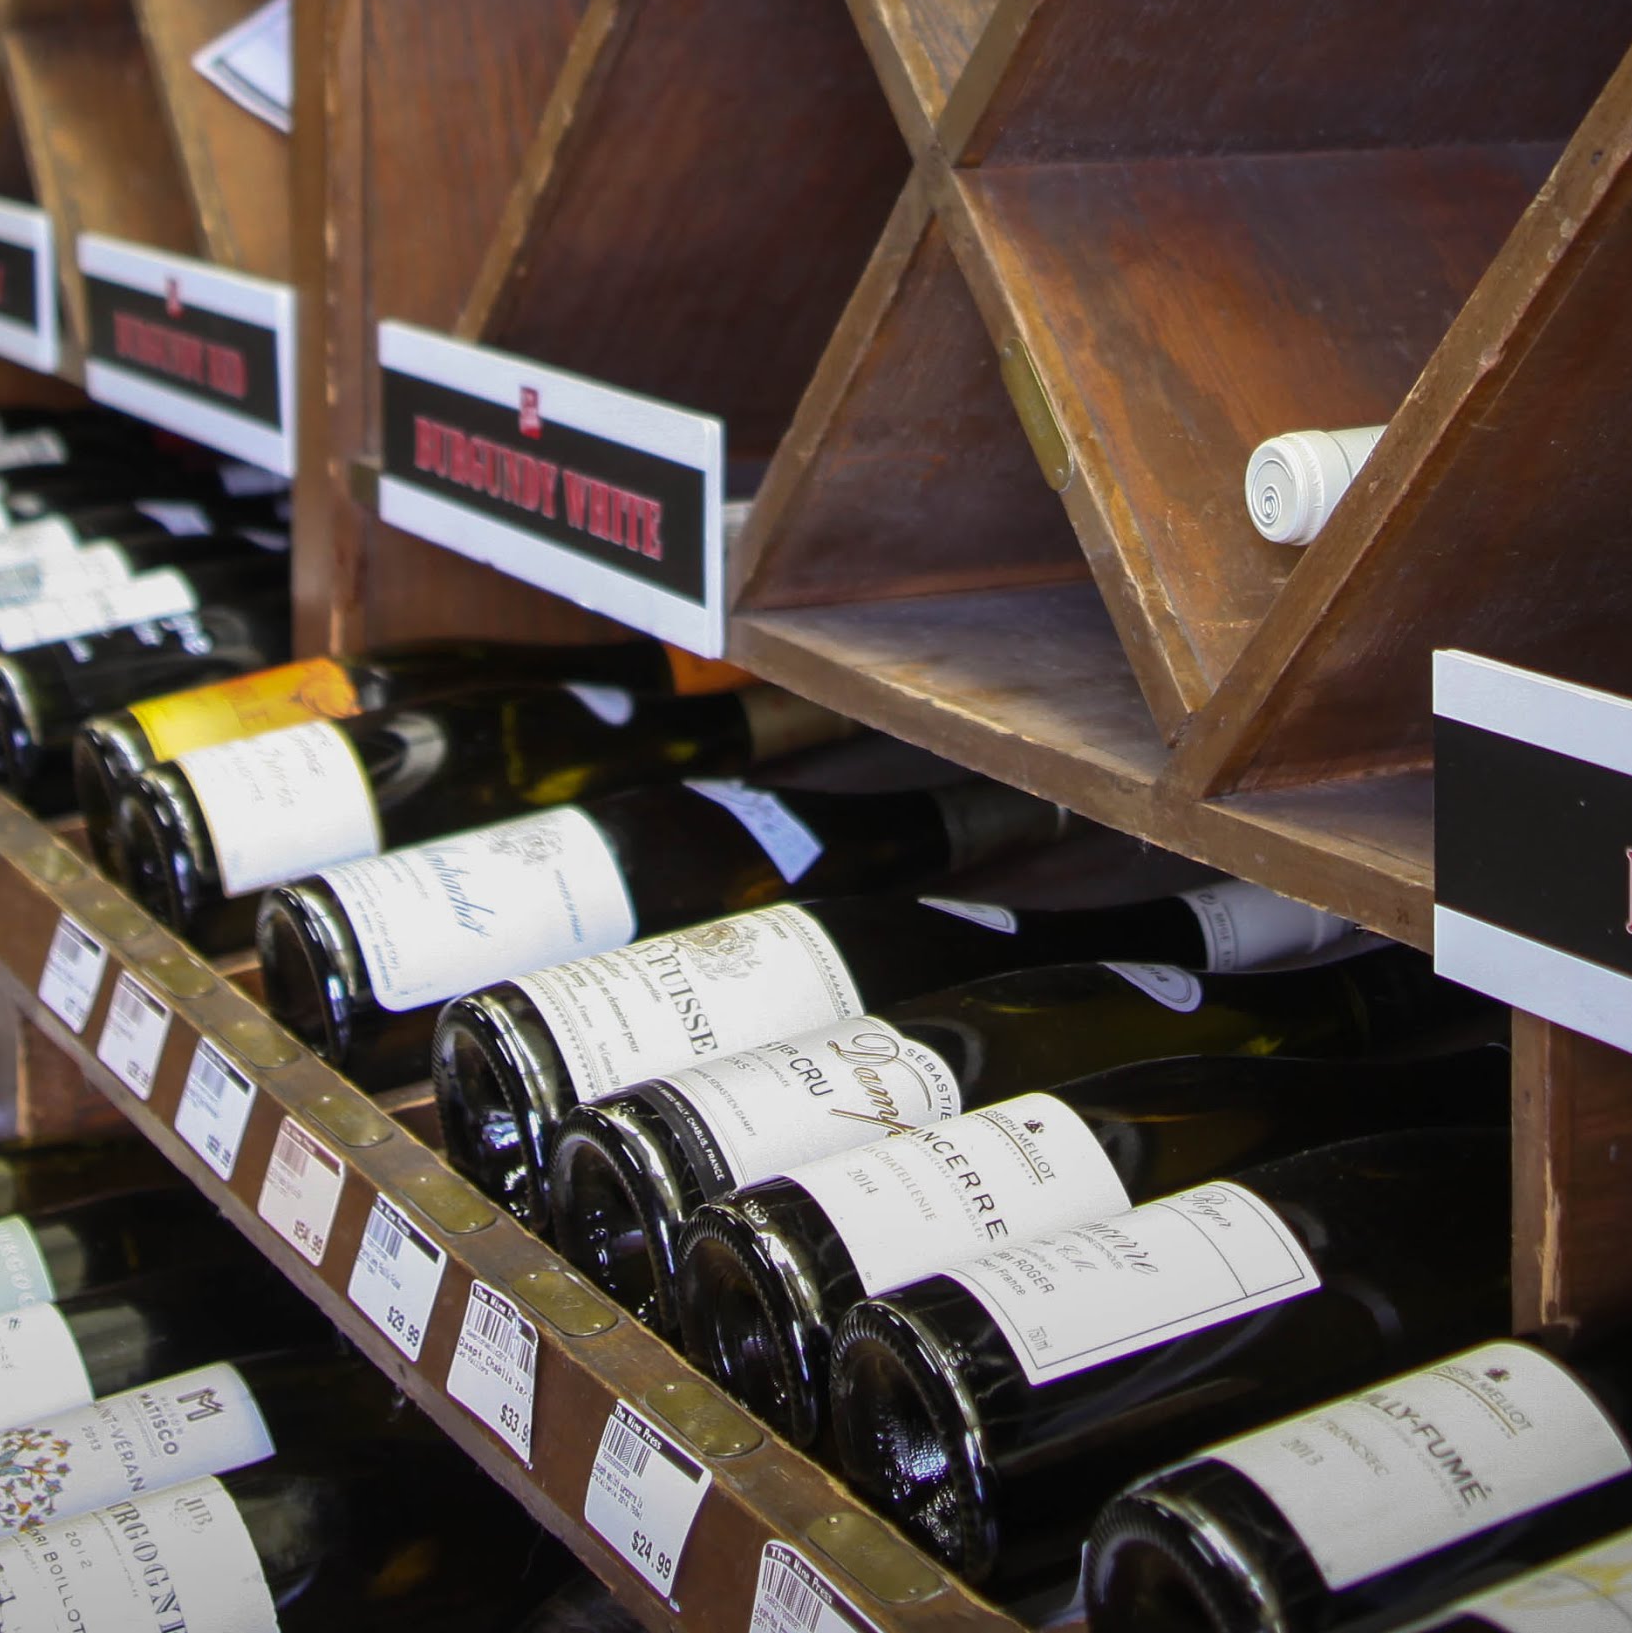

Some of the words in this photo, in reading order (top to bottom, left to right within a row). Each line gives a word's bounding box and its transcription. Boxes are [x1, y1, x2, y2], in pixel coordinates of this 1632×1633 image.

[413, 415, 559, 520] BURGUNDY
[562, 469, 664, 561] WHITE
[790, 1056, 834, 1098] CRU
[904, 1046, 953, 1121] SÉBASTIE
[705, 1147, 725, 1182] FRANCE
[1014, 1132, 1057, 1182] MELLOT
[846, 1168, 880, 1197] 2014
[908, 1126, 1009, 1241] NCERRE
[996, 1263, 1027, 1297] France
[1015, 1257, 1055, 1296] ROGER
[614, 1404, 627, 1424] The
[626, 1415, 643, 1434] Wine
[642, 1426, 663, 1451] Press
[1478, 1380, 1535, 1433] MELLOT
[64, 1531, 93, 1570] 2012
[630, 1529, 673, 1580] $24.99
[770, 1545, 792, 1565] The
[792, 1558, 811, 1583] Wine
[811, 1576, 834, 1605] Press
[43, 1550, 87, 1633] BOILLOT
